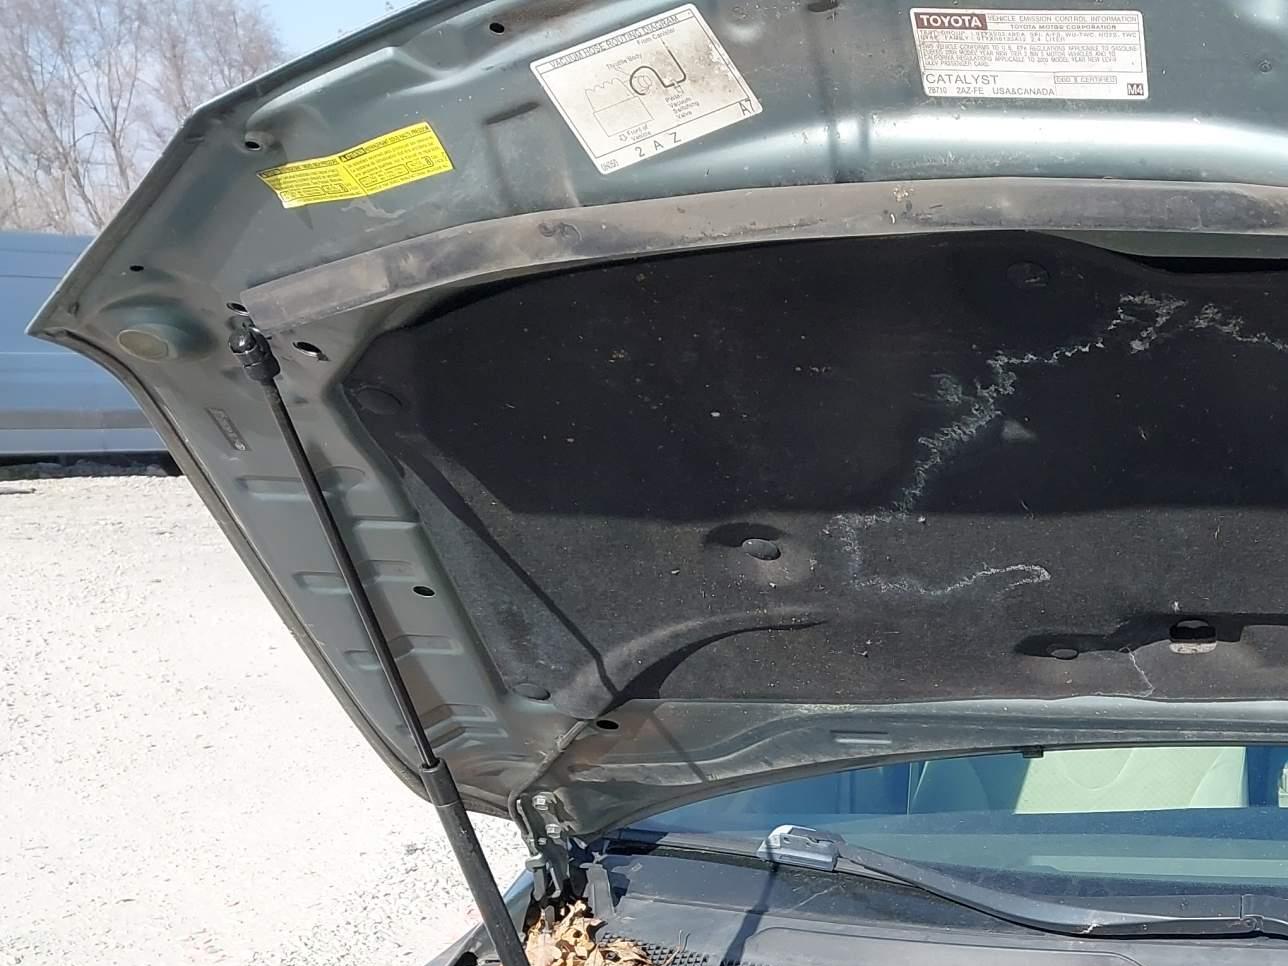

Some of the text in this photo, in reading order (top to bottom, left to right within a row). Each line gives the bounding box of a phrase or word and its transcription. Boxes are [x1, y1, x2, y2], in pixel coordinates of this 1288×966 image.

[920, 15, 982, 28] TOYOTA
[549, 15, 679, 69] VACUUM HOSE ROUTING DIAGRAM
[925, 73, 999, 85] CATALYST
[992, 87, 1055, 96] USA&CANADA
[1127, 84, 1143, 95] M4
[740, 100, 755, 117] A7
[634, 131, 682, 158] 2 A Z
